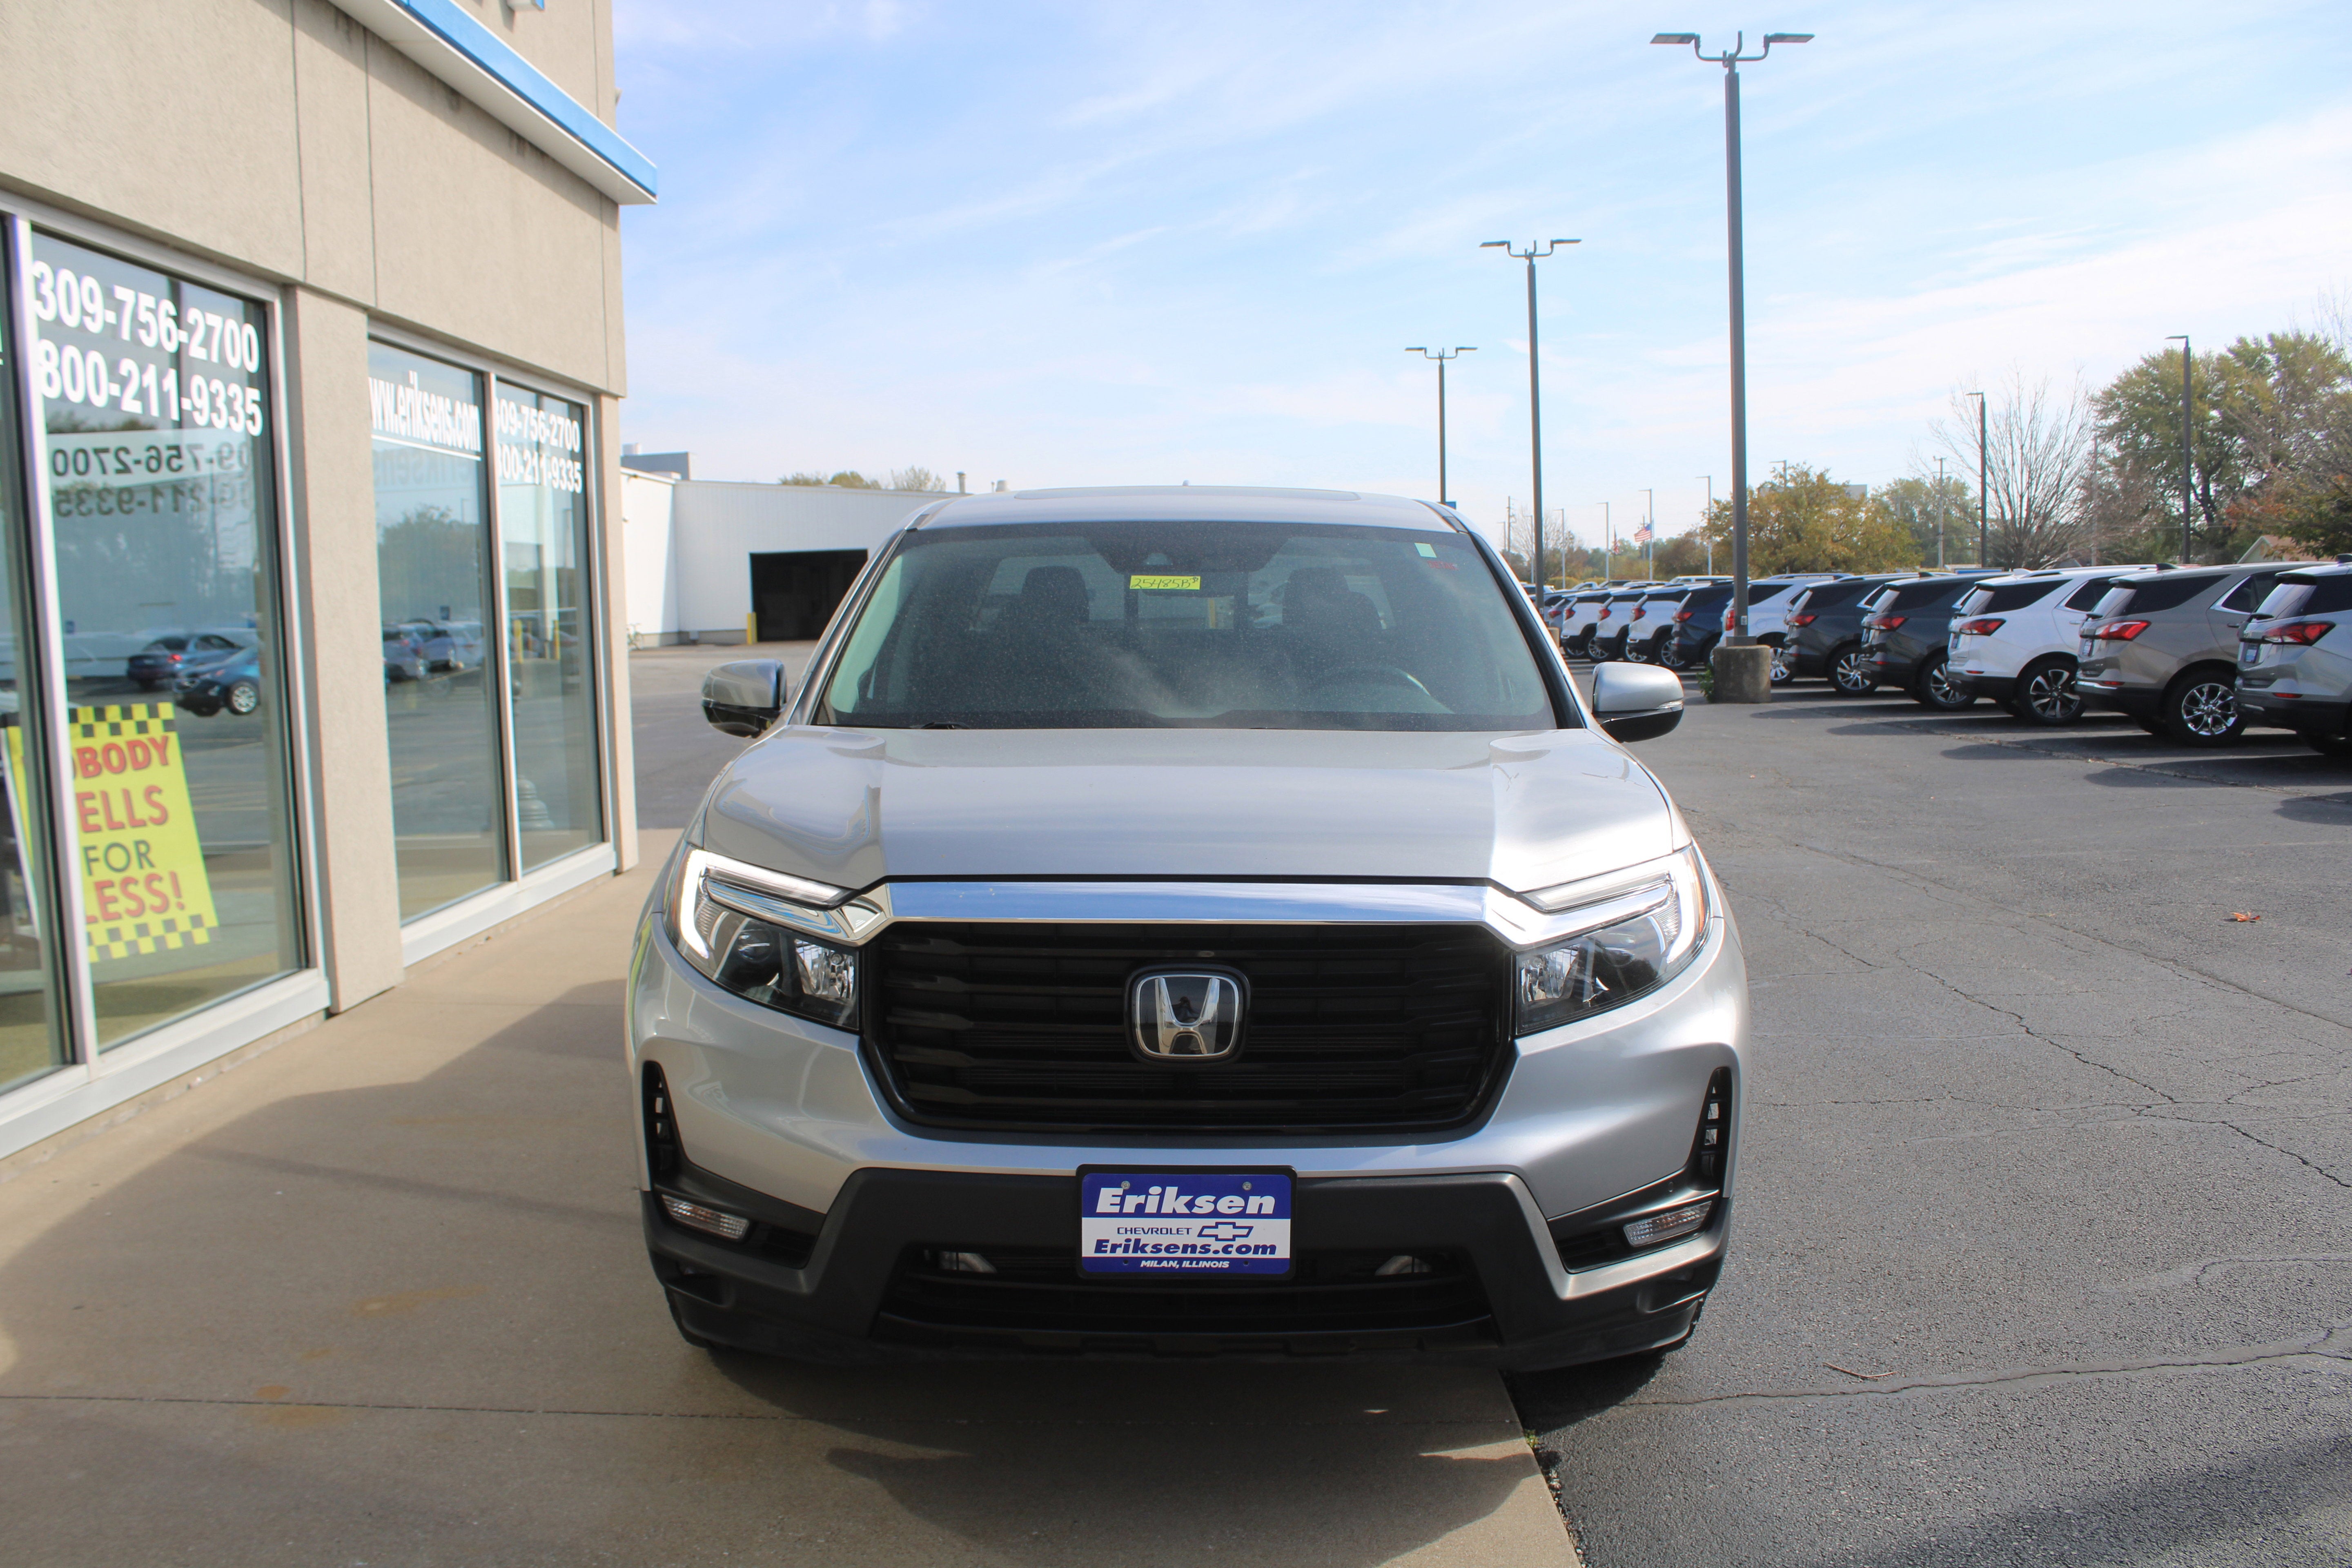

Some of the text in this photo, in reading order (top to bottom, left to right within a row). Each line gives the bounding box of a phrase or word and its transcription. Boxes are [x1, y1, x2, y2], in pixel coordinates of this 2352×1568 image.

[32, 260, 259, 373] 309-756-2700
[38, 339, 263, 437] 800-211-9335
[73, 735, 169, 779] BODY
[83, 840, 155, 876] FOR
[1096, 1186, 1275, 1214] Eriksen
[1094, 1238, 1277, 1255] Eriksens.com
[1117, 1227, 1192, 1235] CHEVROLET
[1140, 1260, 1179, 1269] MILAN,
